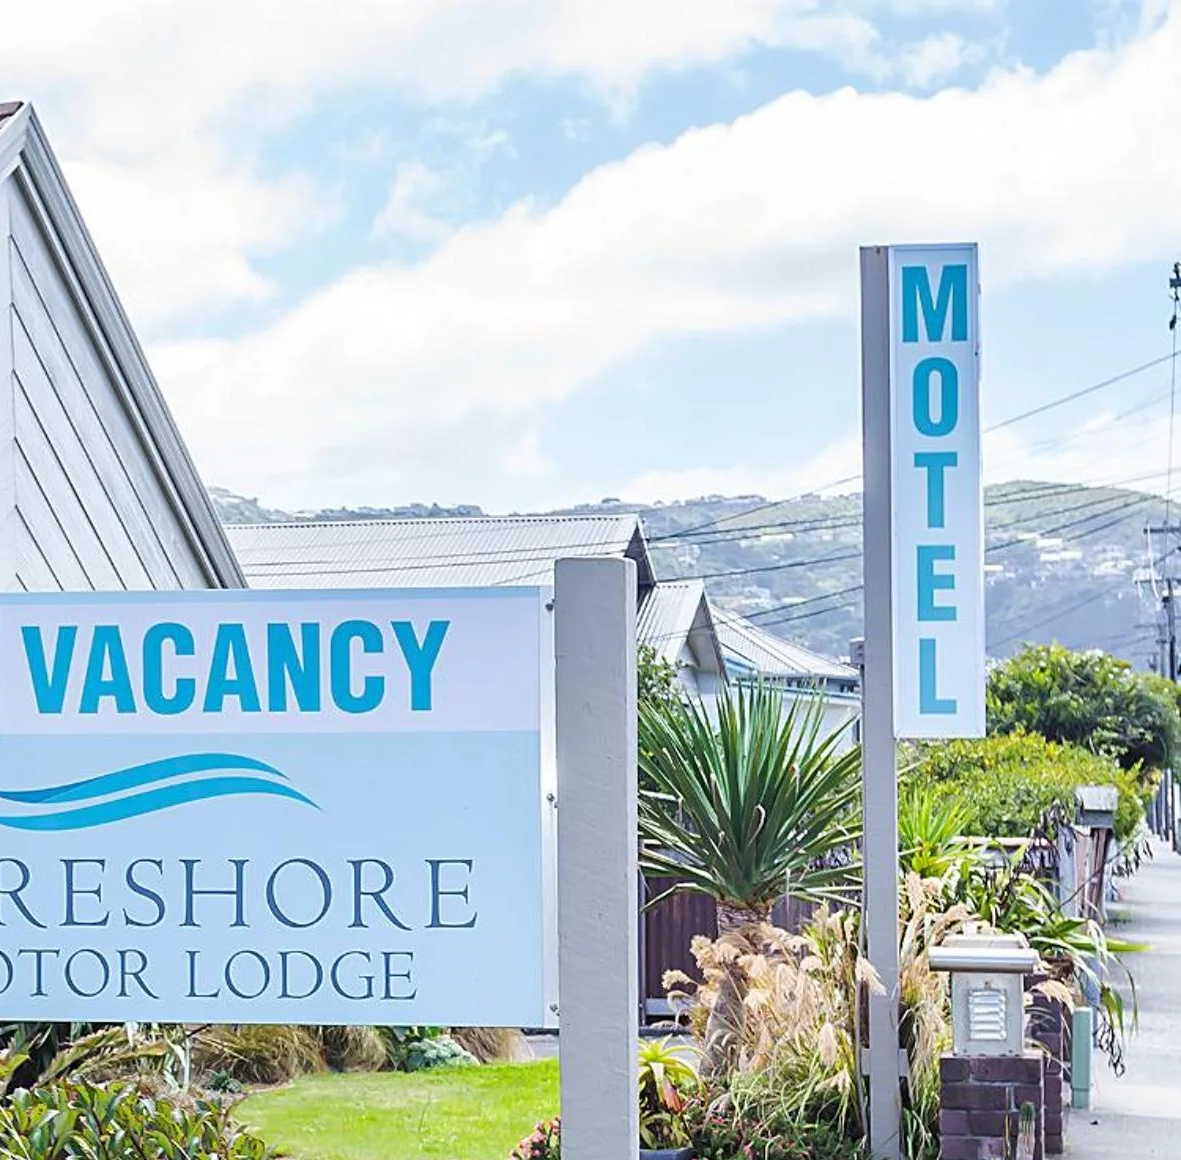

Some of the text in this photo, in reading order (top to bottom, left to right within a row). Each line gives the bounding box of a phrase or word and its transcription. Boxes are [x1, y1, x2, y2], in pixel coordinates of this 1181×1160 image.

[901, 264, 969, 715] MOTEL
[20, 619, 451, 715] VACANCY
[185, 949, 418, 1001] LODGE
